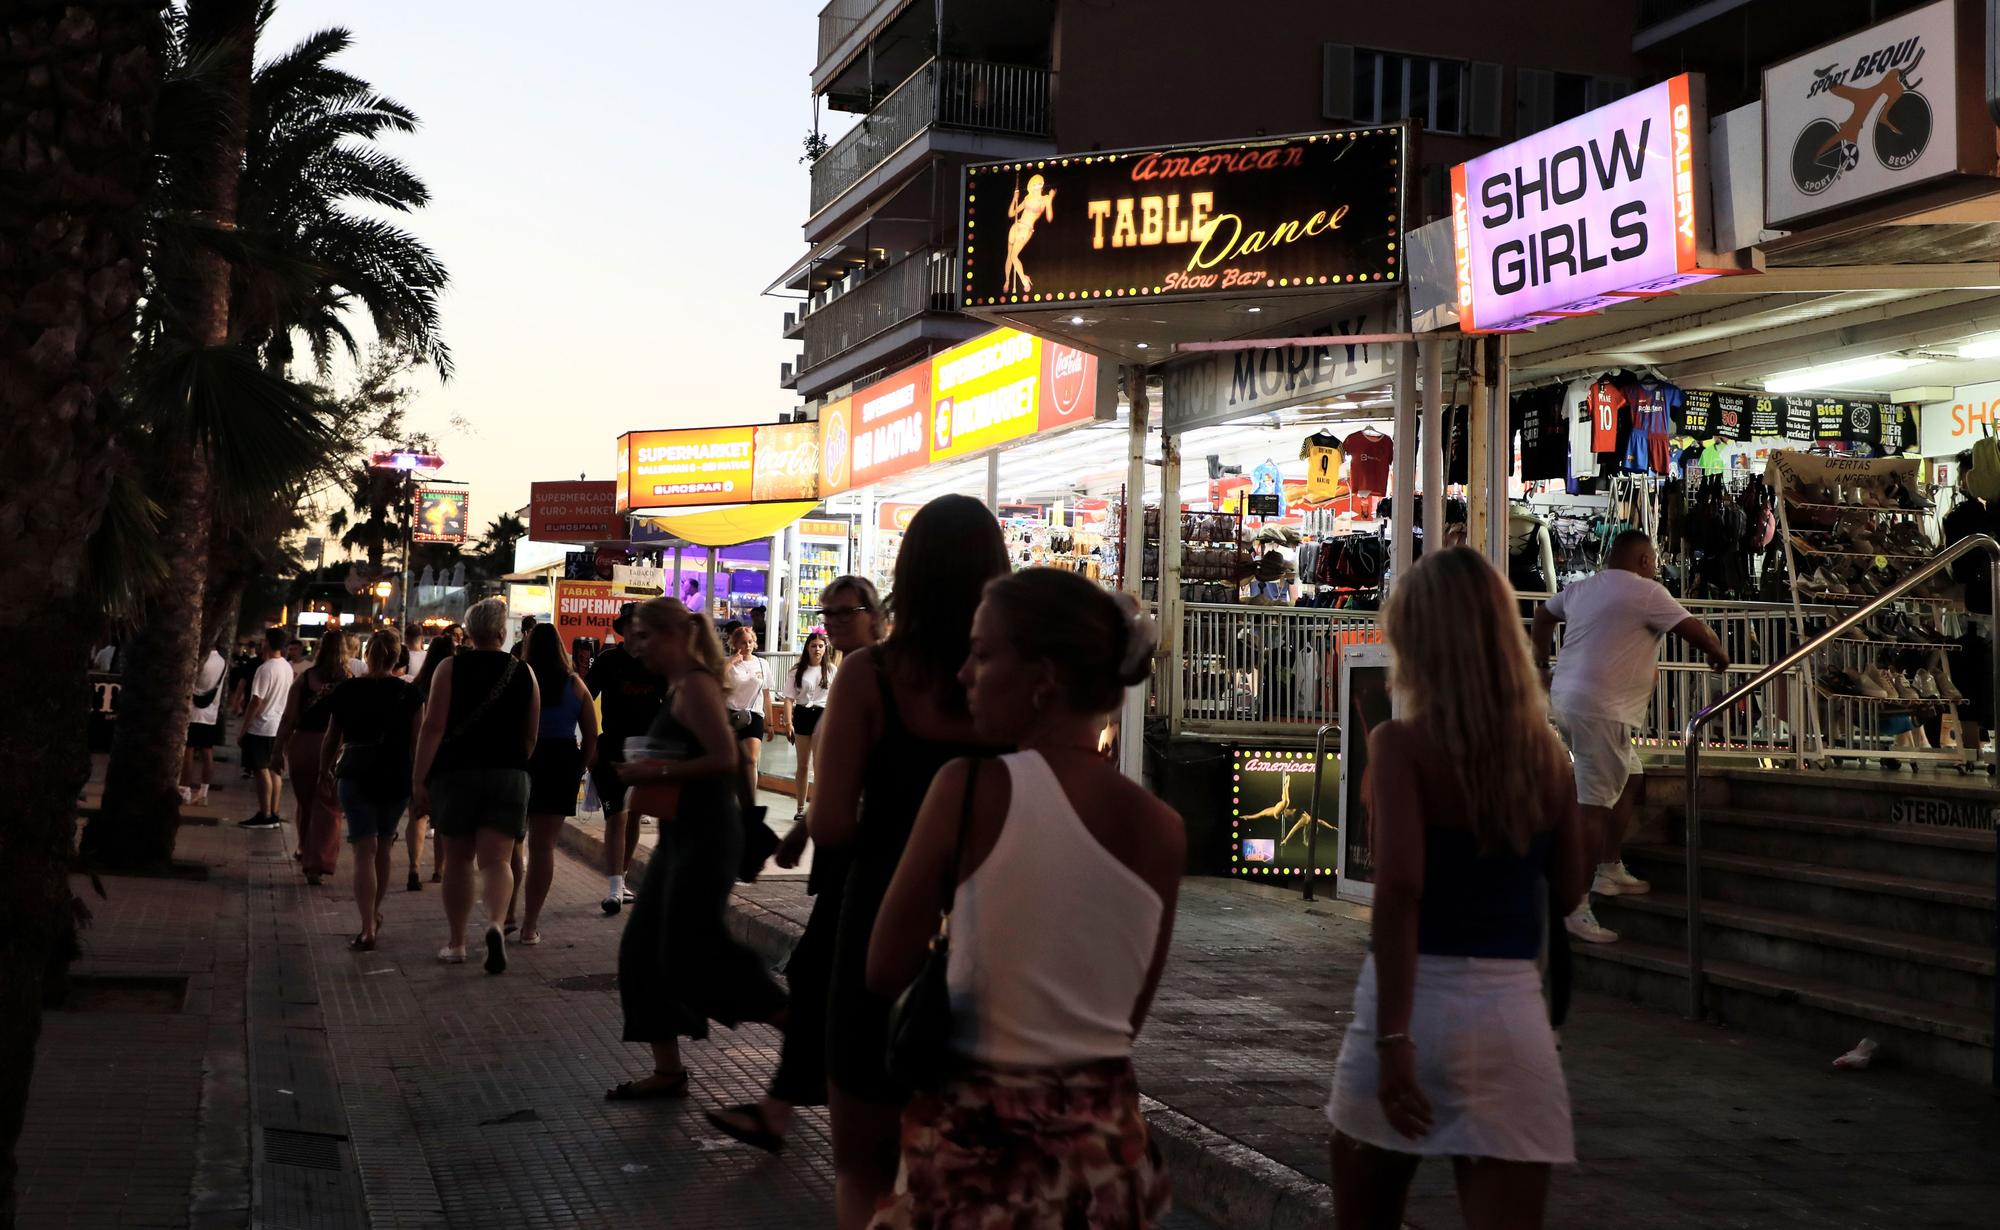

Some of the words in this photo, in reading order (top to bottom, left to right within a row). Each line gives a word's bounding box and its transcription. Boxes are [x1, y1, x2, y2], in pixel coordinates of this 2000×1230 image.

[1807, 69, 1850, 99] SPORT
[1850, 35, 1920, 82] BEQUI
[1131, 147, 1304, 182] American
[1888, 149, 1918, 166] BEQUI
[1481, 117, 1651, 229] SHOW
[1674, 103, 1694, 238] GALERY
[1804, 174, 1831, 190] SPORT
[1088, 191, 1215, 250] TABLE
[1186, 204, 1350, 272] Dance
[1491, 200, 1649, 296] GIRLS
[1162, 271, 1218, 293] Show
[1222, 268, 1267, 287] Bar
[1229, 314, 1367, 405] MOREY
[1756, 399, 1772, 412] 50
[1786, 396, 1803, 406] Nach
[1803, 399, 1813, 407] 40
[1787, 405, 1811, 417] Jahren
[1816, 404, 1844, 416] BIER
[1878, 403, 1896, 414] GEH
[1599, 405, 1613, 431] 10
[1880, 413, 1897, 424] MAL
[873, 411, 923, 465] MATIAS
[1881, 424, 1902, 436] BIER
[638, 441, 751, 463] SUPERMARKET
[1321, 454, 1329, 476] 9
[1772, 451, 1796, 483] SALES
[1825, 459, 1871, 470] OFERTAS
[654, 482, 722, 495] EUROSPAR
[562, 588, 598, 596] TABAK
[560, 615, 582, 626] Bei
